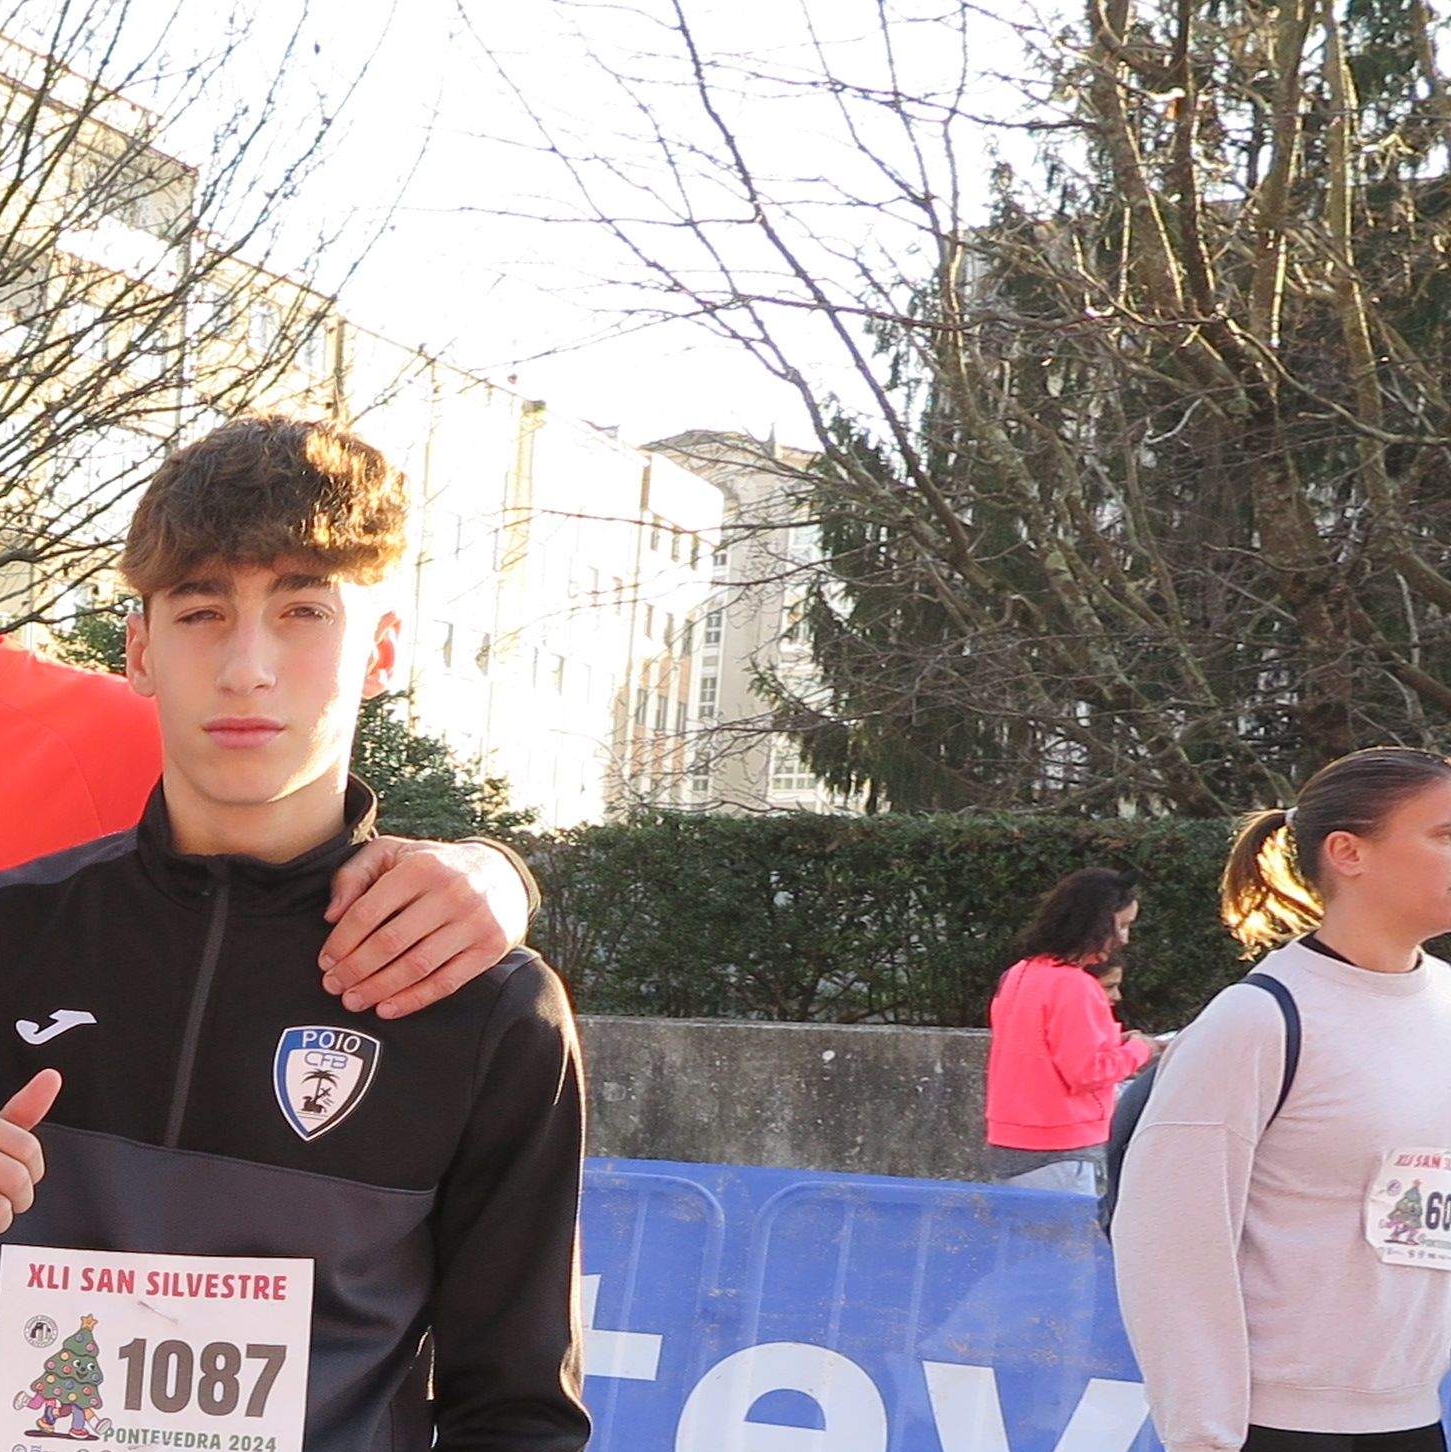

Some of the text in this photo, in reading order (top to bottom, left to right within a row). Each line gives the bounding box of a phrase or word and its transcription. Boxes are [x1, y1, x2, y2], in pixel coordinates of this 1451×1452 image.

[302, 1030, 361, 1053] POIO
[27, 1263, 287, 1300] XLI SAN SILVESTRE
[118, 1338, 288, 1418] 1087
[103, 1427, 276, 1452] PONTEVEDRA 2024
